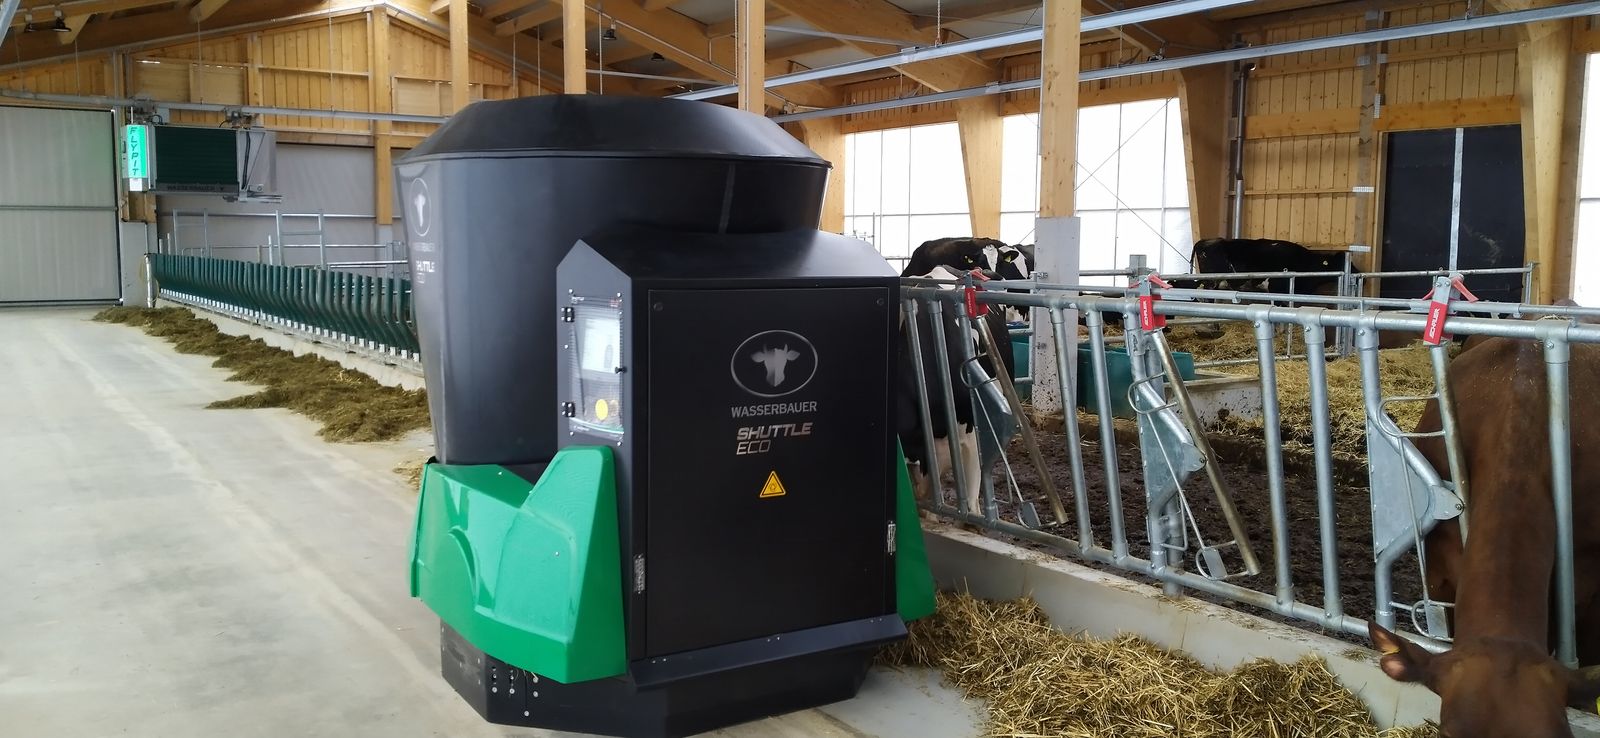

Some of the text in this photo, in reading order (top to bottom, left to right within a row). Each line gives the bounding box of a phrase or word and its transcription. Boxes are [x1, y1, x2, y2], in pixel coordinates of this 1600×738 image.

[129, 127, 139, 176] FLYPIT
[731, 401, 817, 418] WASSERBAUER
[737, 422, 813, 440] SHUTTLE
[736, 440, 771, 455] ECO
